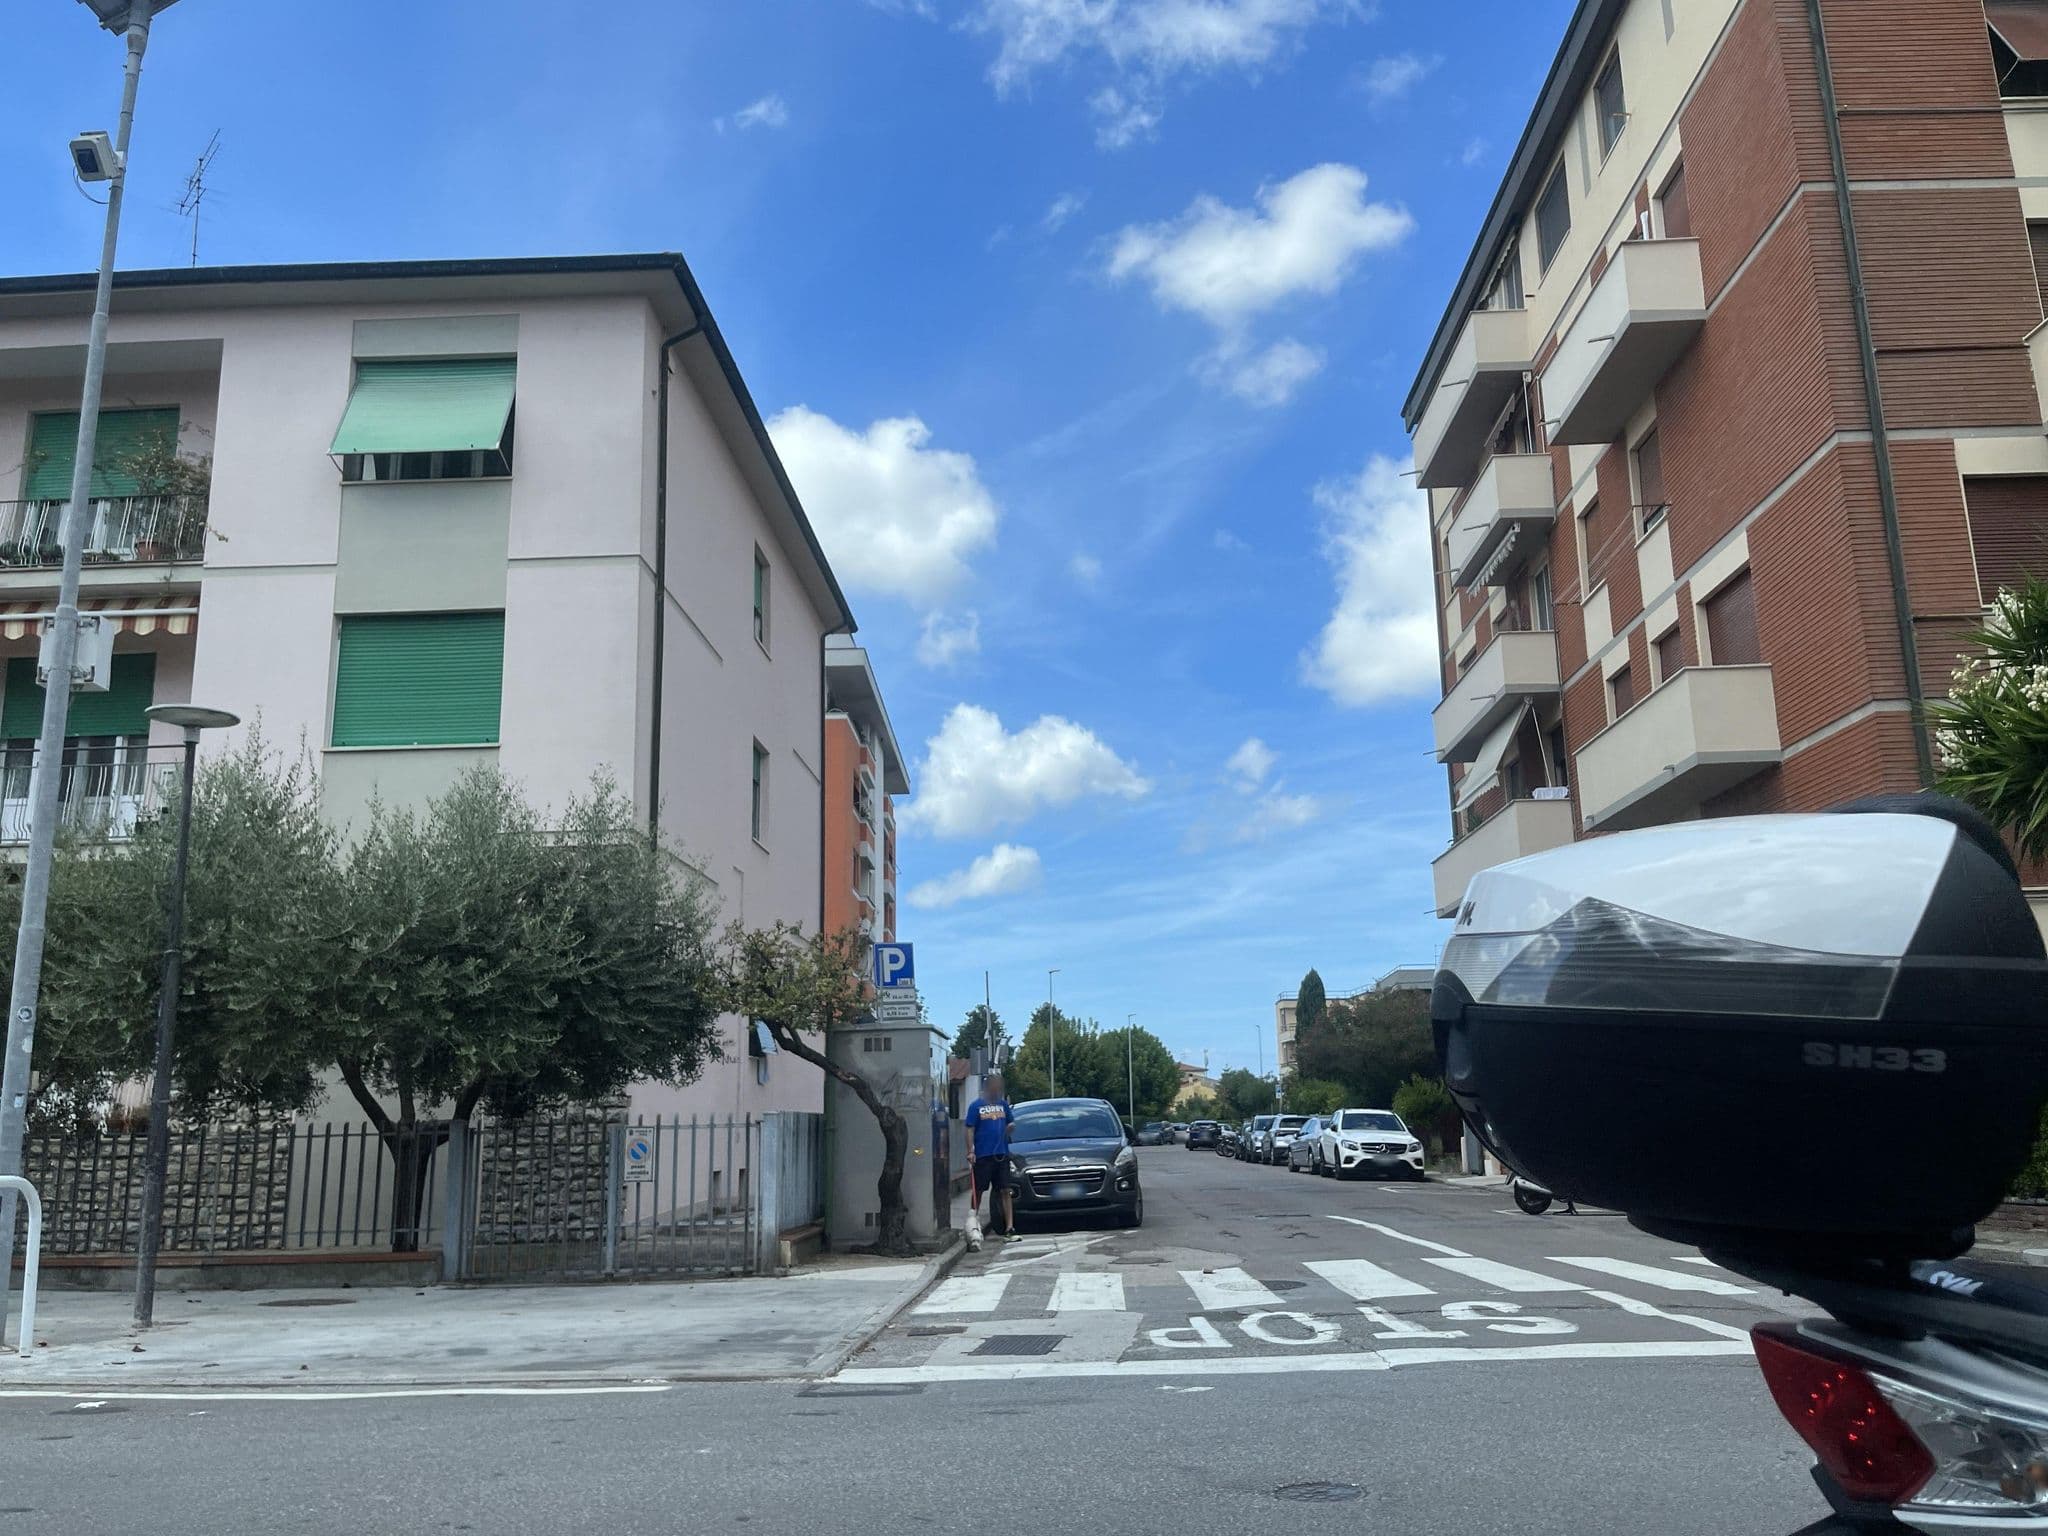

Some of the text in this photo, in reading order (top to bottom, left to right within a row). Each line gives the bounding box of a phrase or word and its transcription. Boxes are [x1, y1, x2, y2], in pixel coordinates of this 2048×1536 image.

[878, 948, 906, 982] P
[1803, 1042, 1947, 1072] SH33
[1149, 1301, 1580, 1348] STOP
